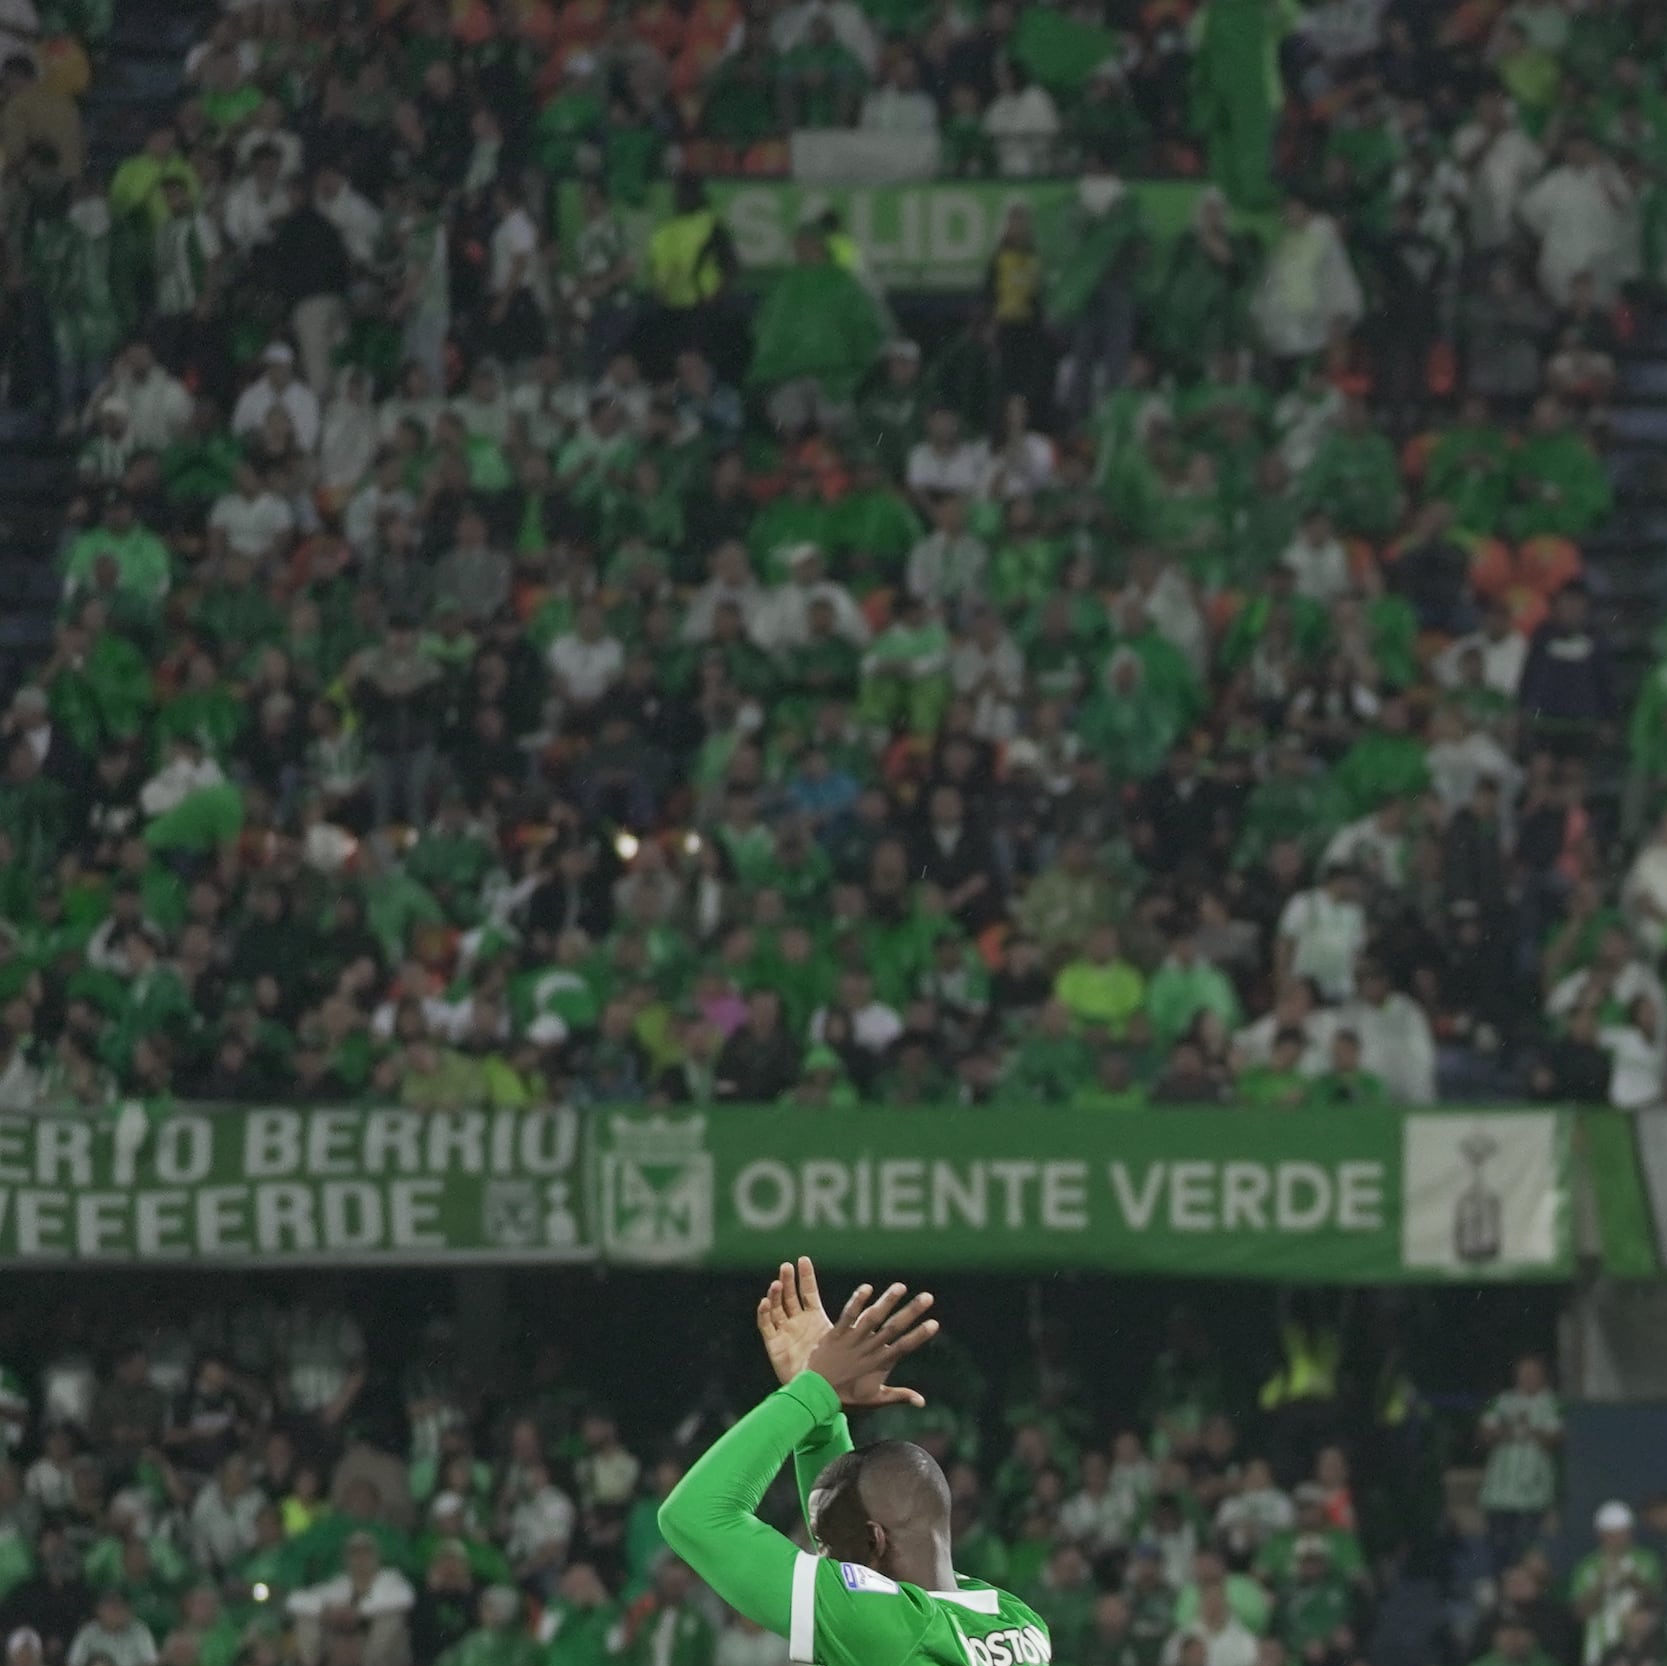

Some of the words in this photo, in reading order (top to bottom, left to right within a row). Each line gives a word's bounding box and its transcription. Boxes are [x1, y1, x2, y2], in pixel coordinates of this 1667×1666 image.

[0, 1179, 446, 1260] EEEERDE
[734, 1154, 1090, 1232] ORIENTE
[1112, 1160, 1385, 1231] VERDE
